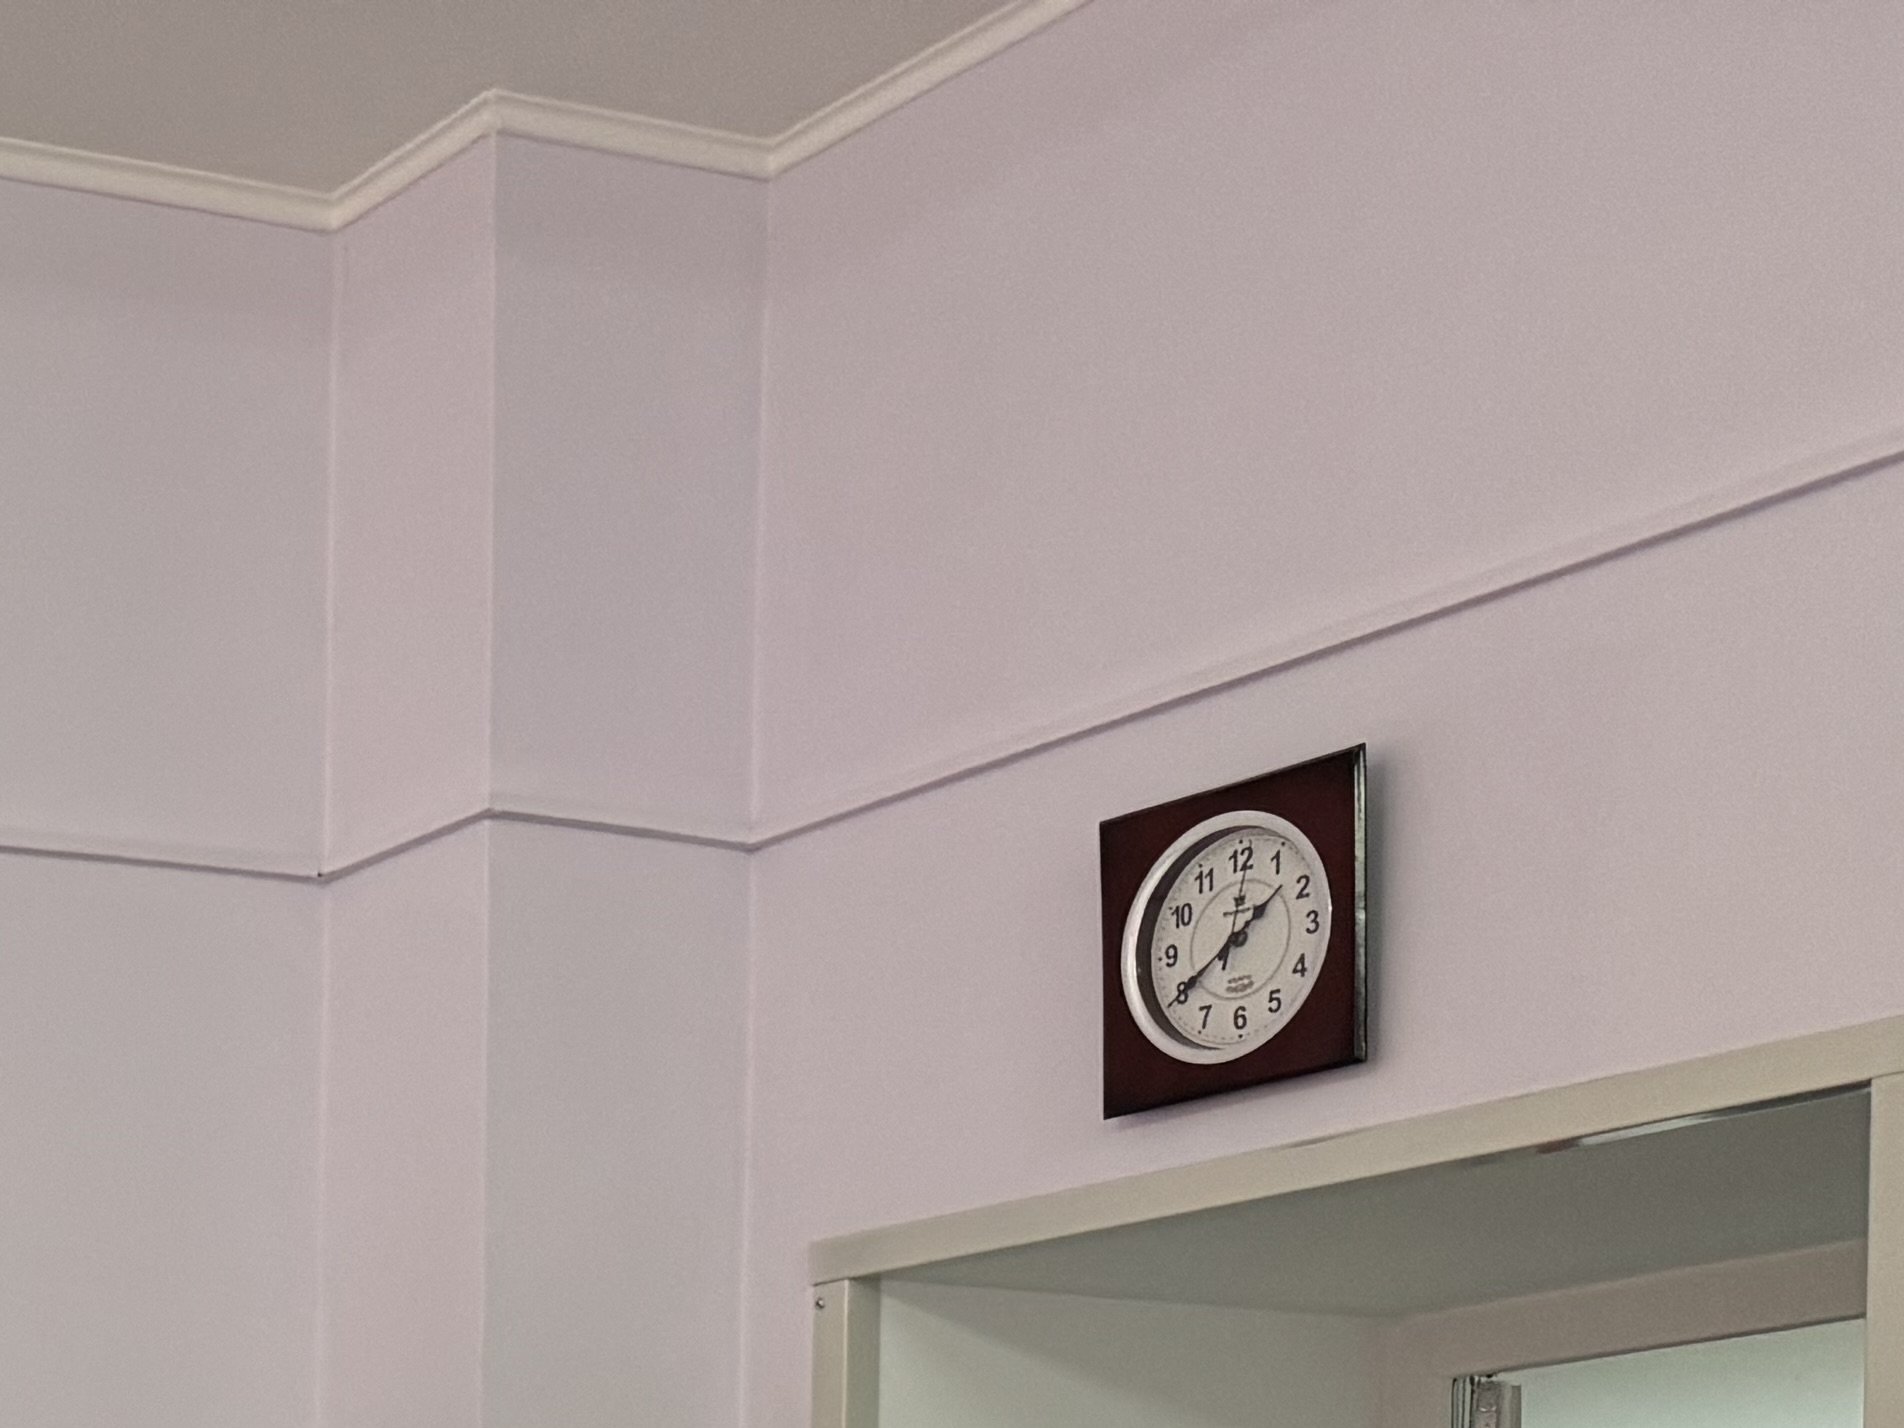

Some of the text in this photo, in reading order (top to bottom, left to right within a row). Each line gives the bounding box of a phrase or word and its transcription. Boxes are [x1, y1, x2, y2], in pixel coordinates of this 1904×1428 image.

[1228, 846, 1254, 874] 12
[1270, 850, 1281, 875] 1
[1194, 868, 1214, 894] 11
[1295, 874, 1310, 900] 2
[1171, 903, 1193, 929] 10
[1305, 910, 1320, 934] 3
[1164, 944, 1178, 967] 9
[1292, 953, 1308, 977] 4
[1176, 981, 1189, 1004] 8
[1268, 988, 1282, 1013] 5
[1198, 1004, 1213, 1029] 7
[1233, 1006, 1247, 1030] 6
